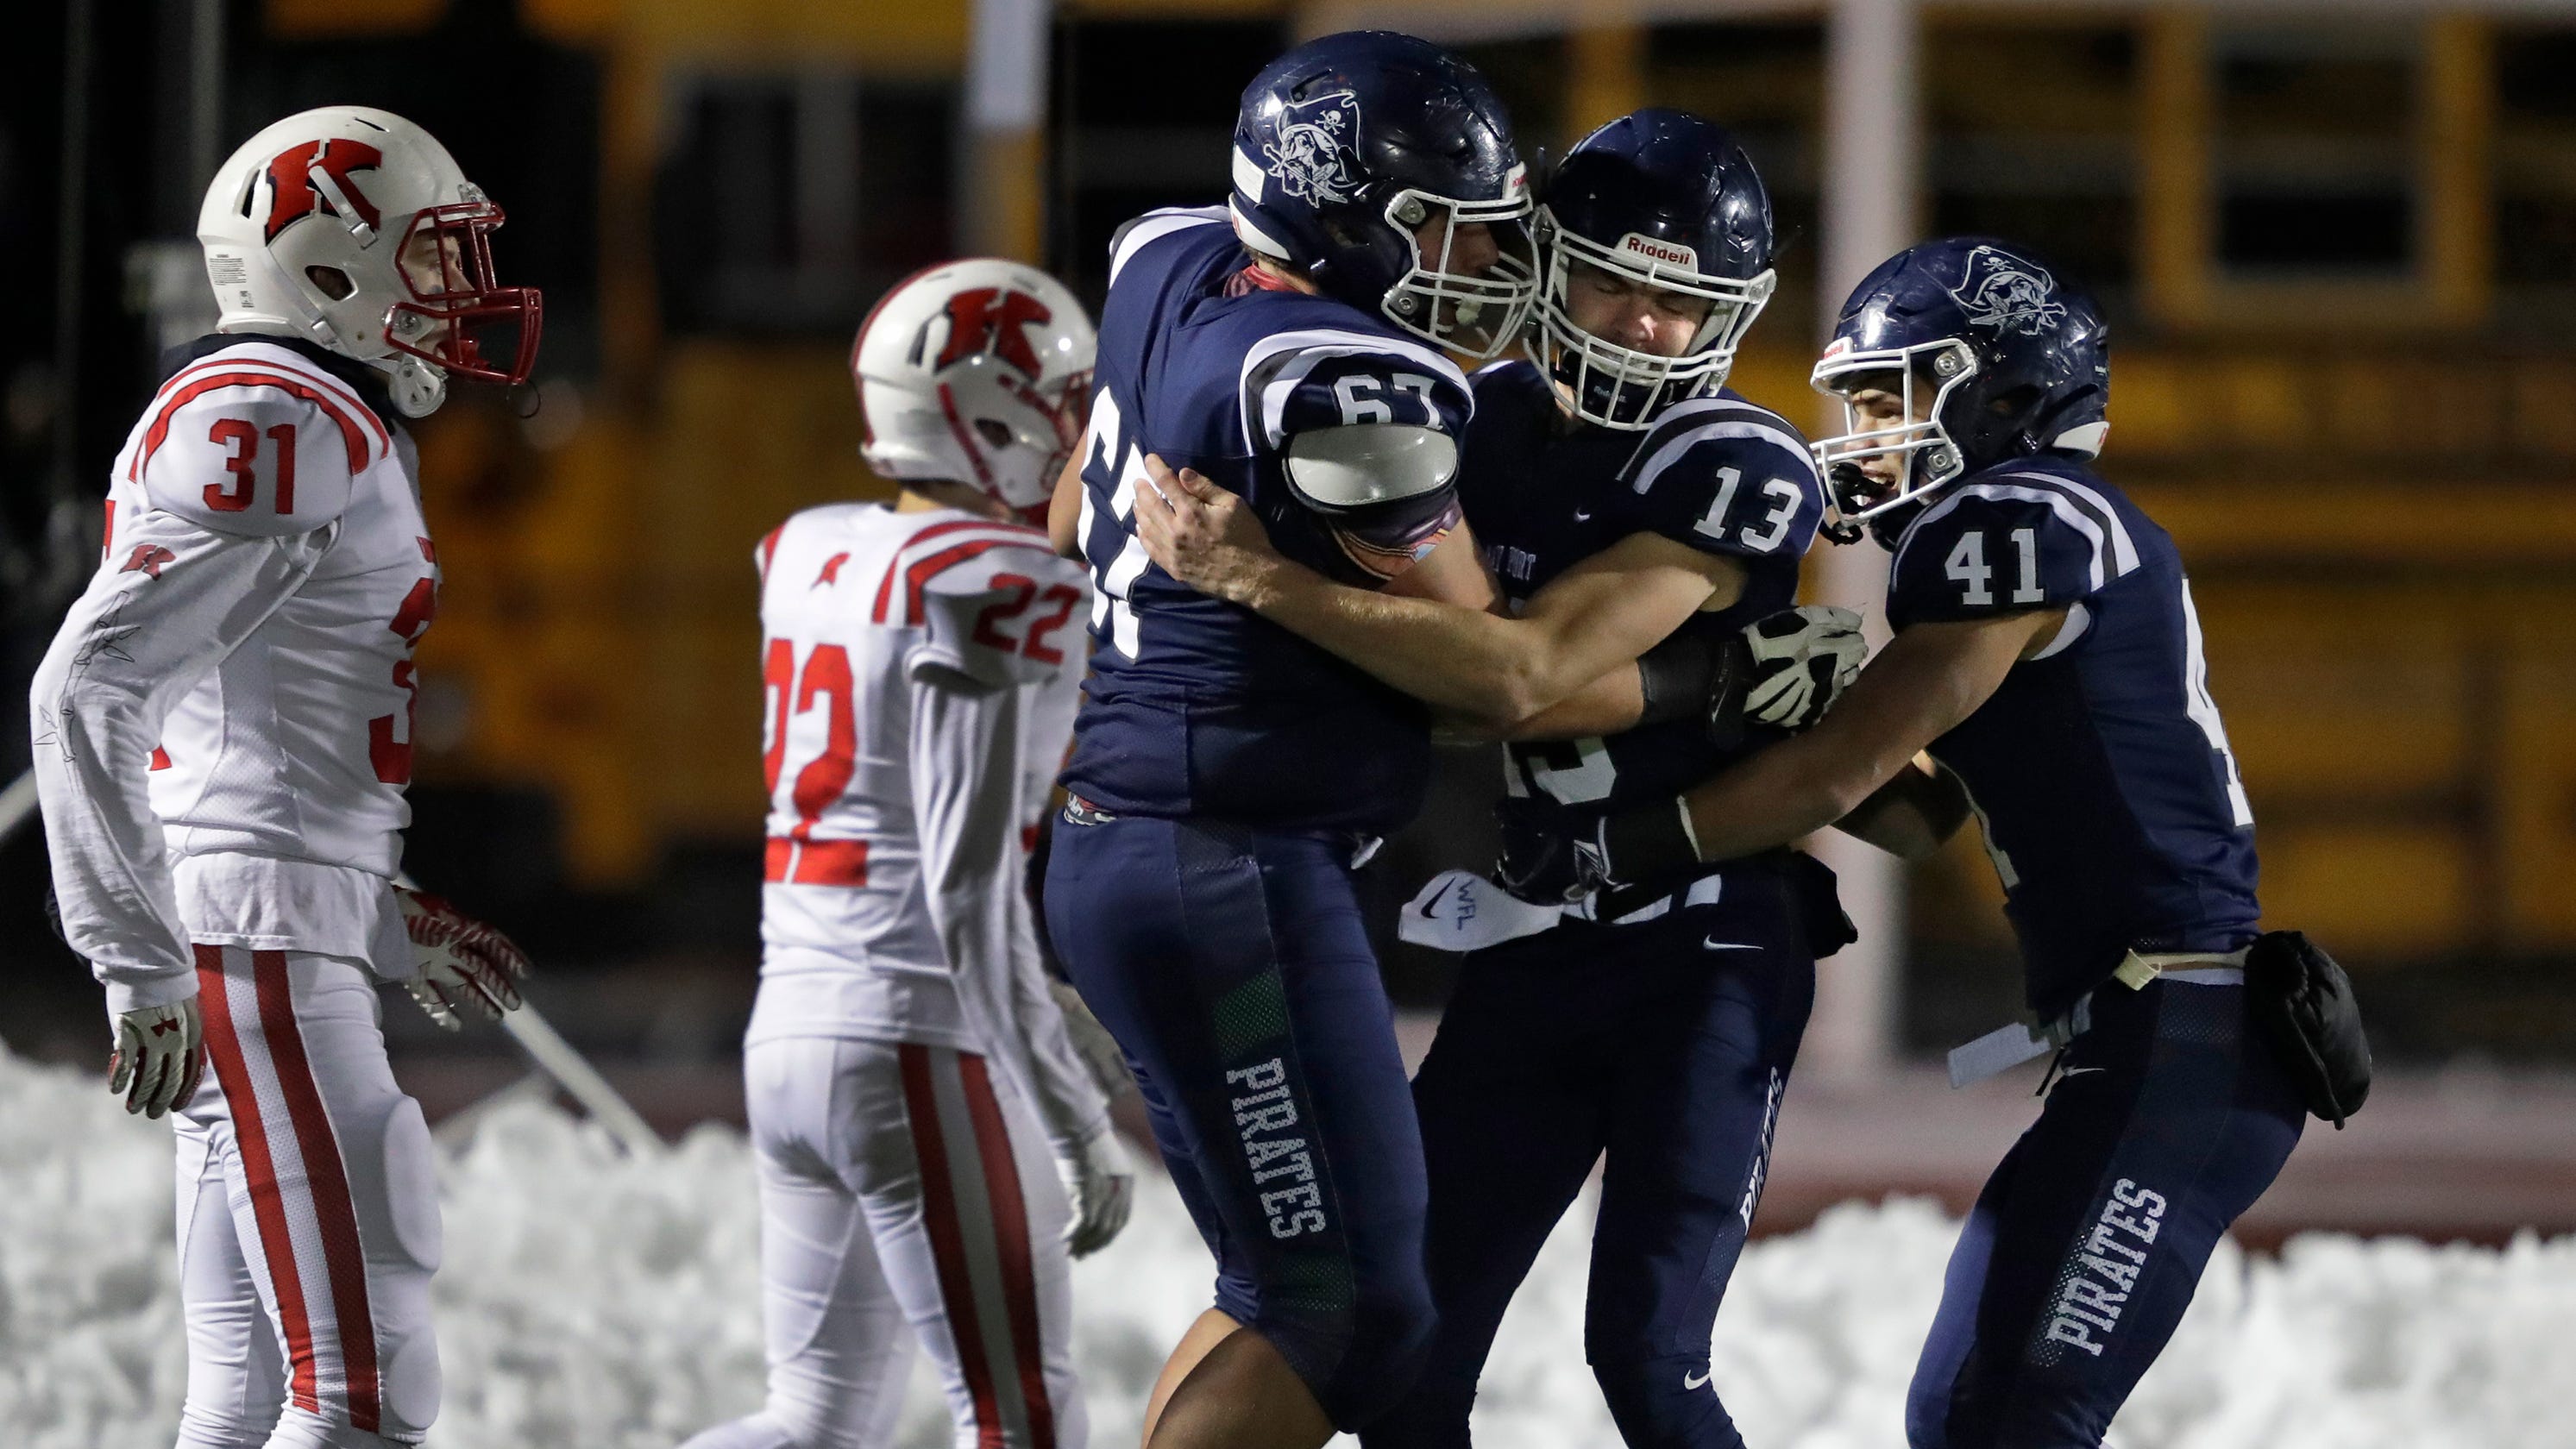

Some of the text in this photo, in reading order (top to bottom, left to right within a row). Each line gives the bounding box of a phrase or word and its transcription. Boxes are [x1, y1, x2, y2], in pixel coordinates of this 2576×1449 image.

[1627, 236, 1691, 265] Riddell
[1334, 373, 1443, 430] 67
[203, 419, 297, 515] 31
[1693, 467, 1803, 553] 13
[1945, 528, 2045, 605] 41
[971, 573, 1078, 665] 22
[1226, 1057, 1327, 1239] PIRATES
[1739, 1066, 1782, 1235] PIRATES
[2045, 1177, 2167, 1357] PIRATES
